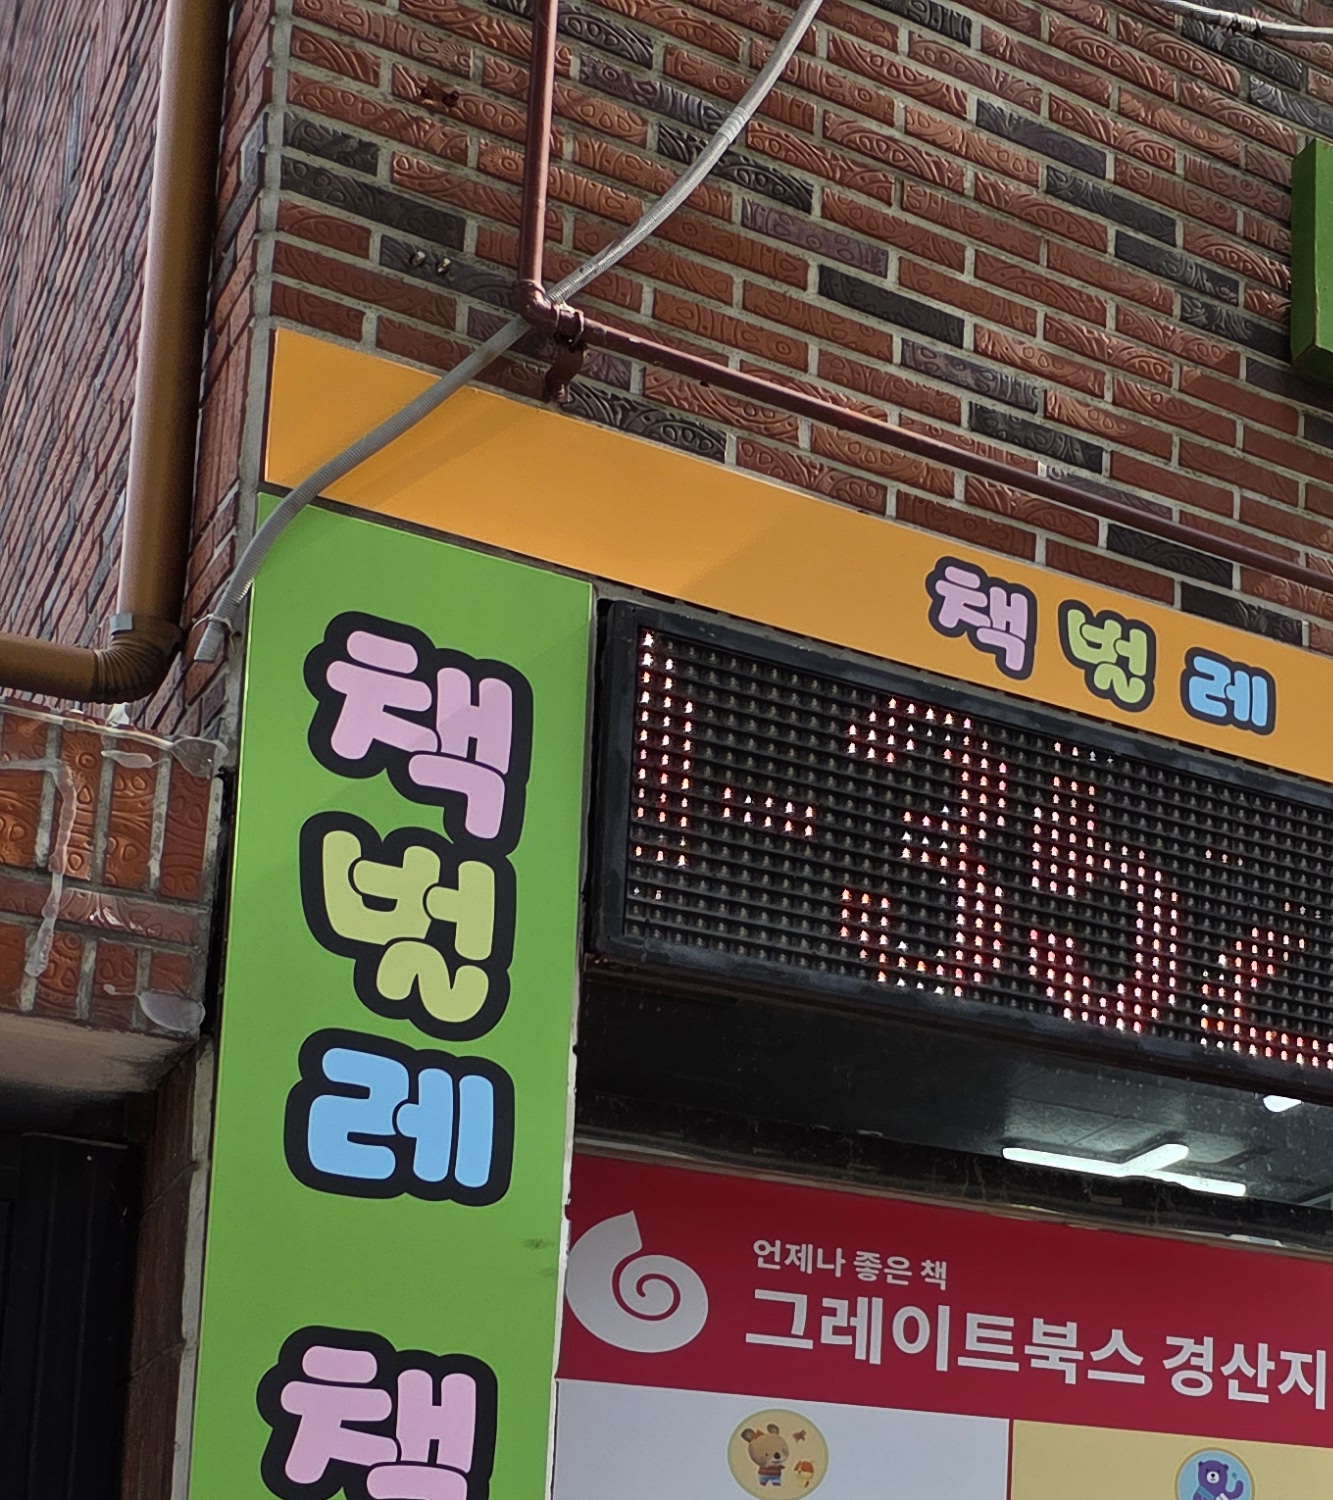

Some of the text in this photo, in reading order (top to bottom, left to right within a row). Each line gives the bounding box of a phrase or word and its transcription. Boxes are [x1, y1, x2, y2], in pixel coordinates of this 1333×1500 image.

[926, 556, 1276, 737] 책벌레
[286, 611, 532, 1206] 책벌레
[751, 1238, 949, 1291] 언제나 좋은 책
[744, 1287, 1146, 1386] 그레이트북스
